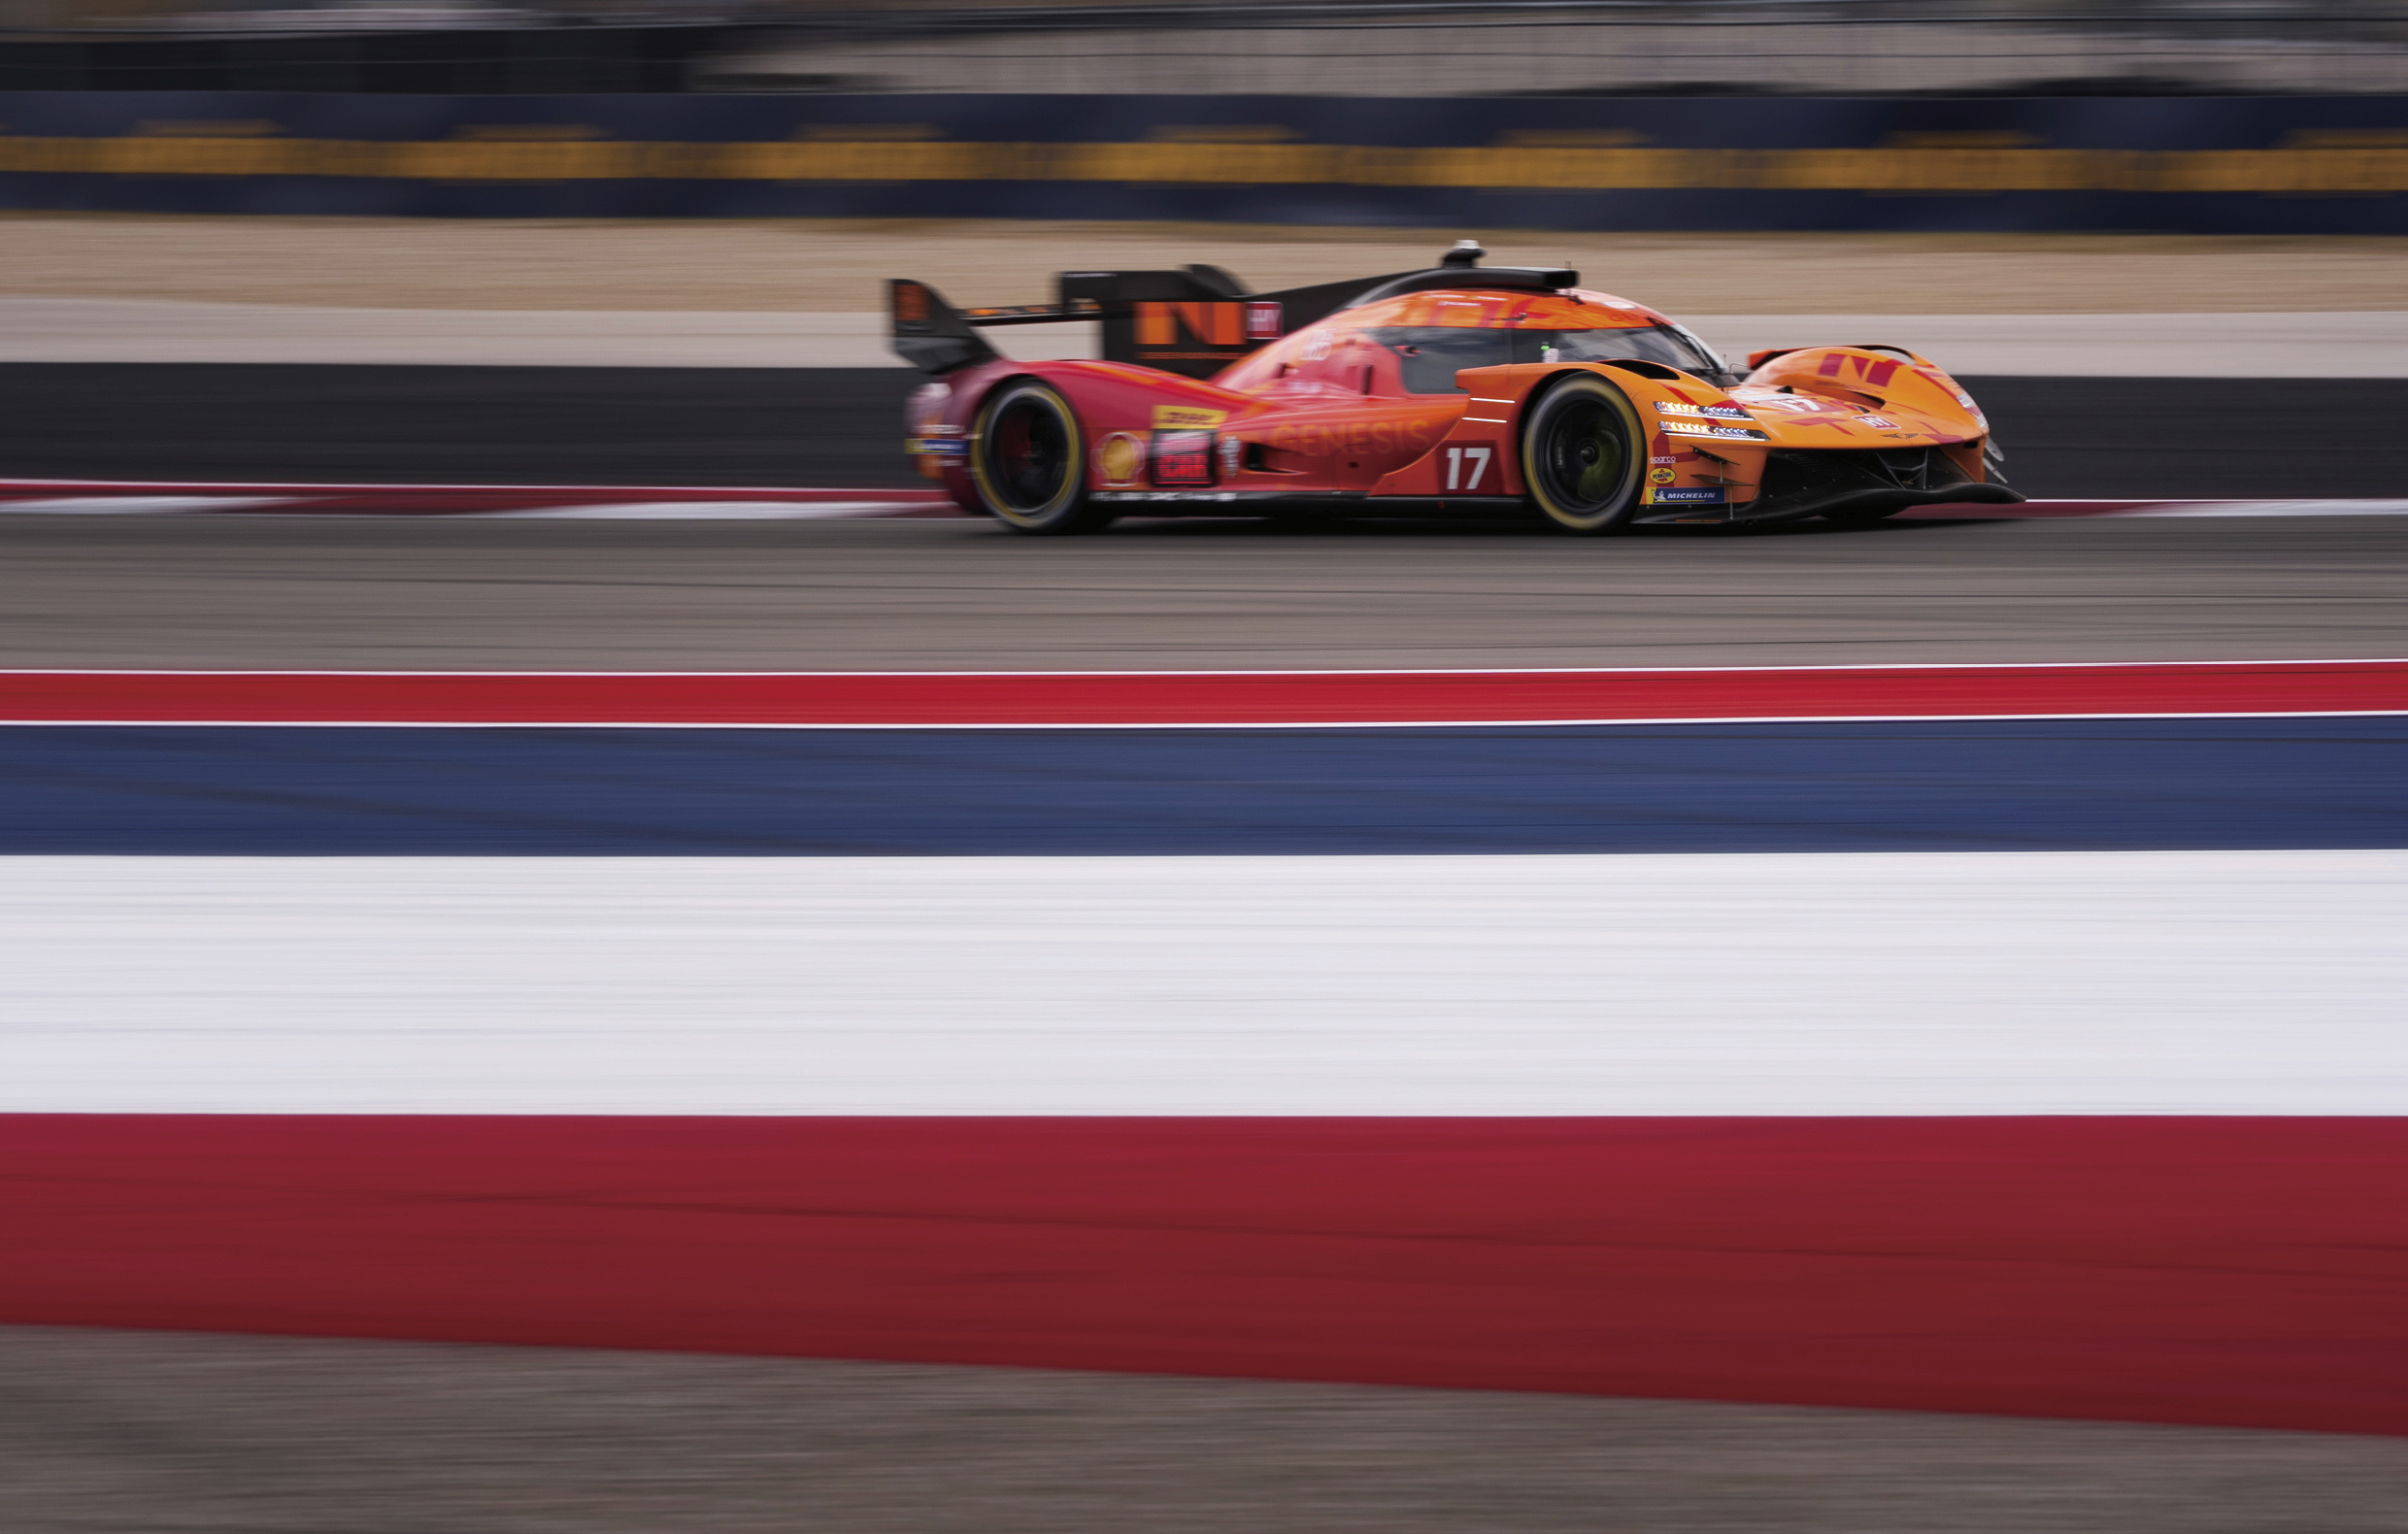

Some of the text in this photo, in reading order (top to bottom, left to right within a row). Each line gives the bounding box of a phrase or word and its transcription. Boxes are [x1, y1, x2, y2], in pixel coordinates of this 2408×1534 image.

[1772, 399, 1822, 412] 17
[1270, 419, 1431, 456] GENESIS
[1446, 448, 1491, 490] 17
